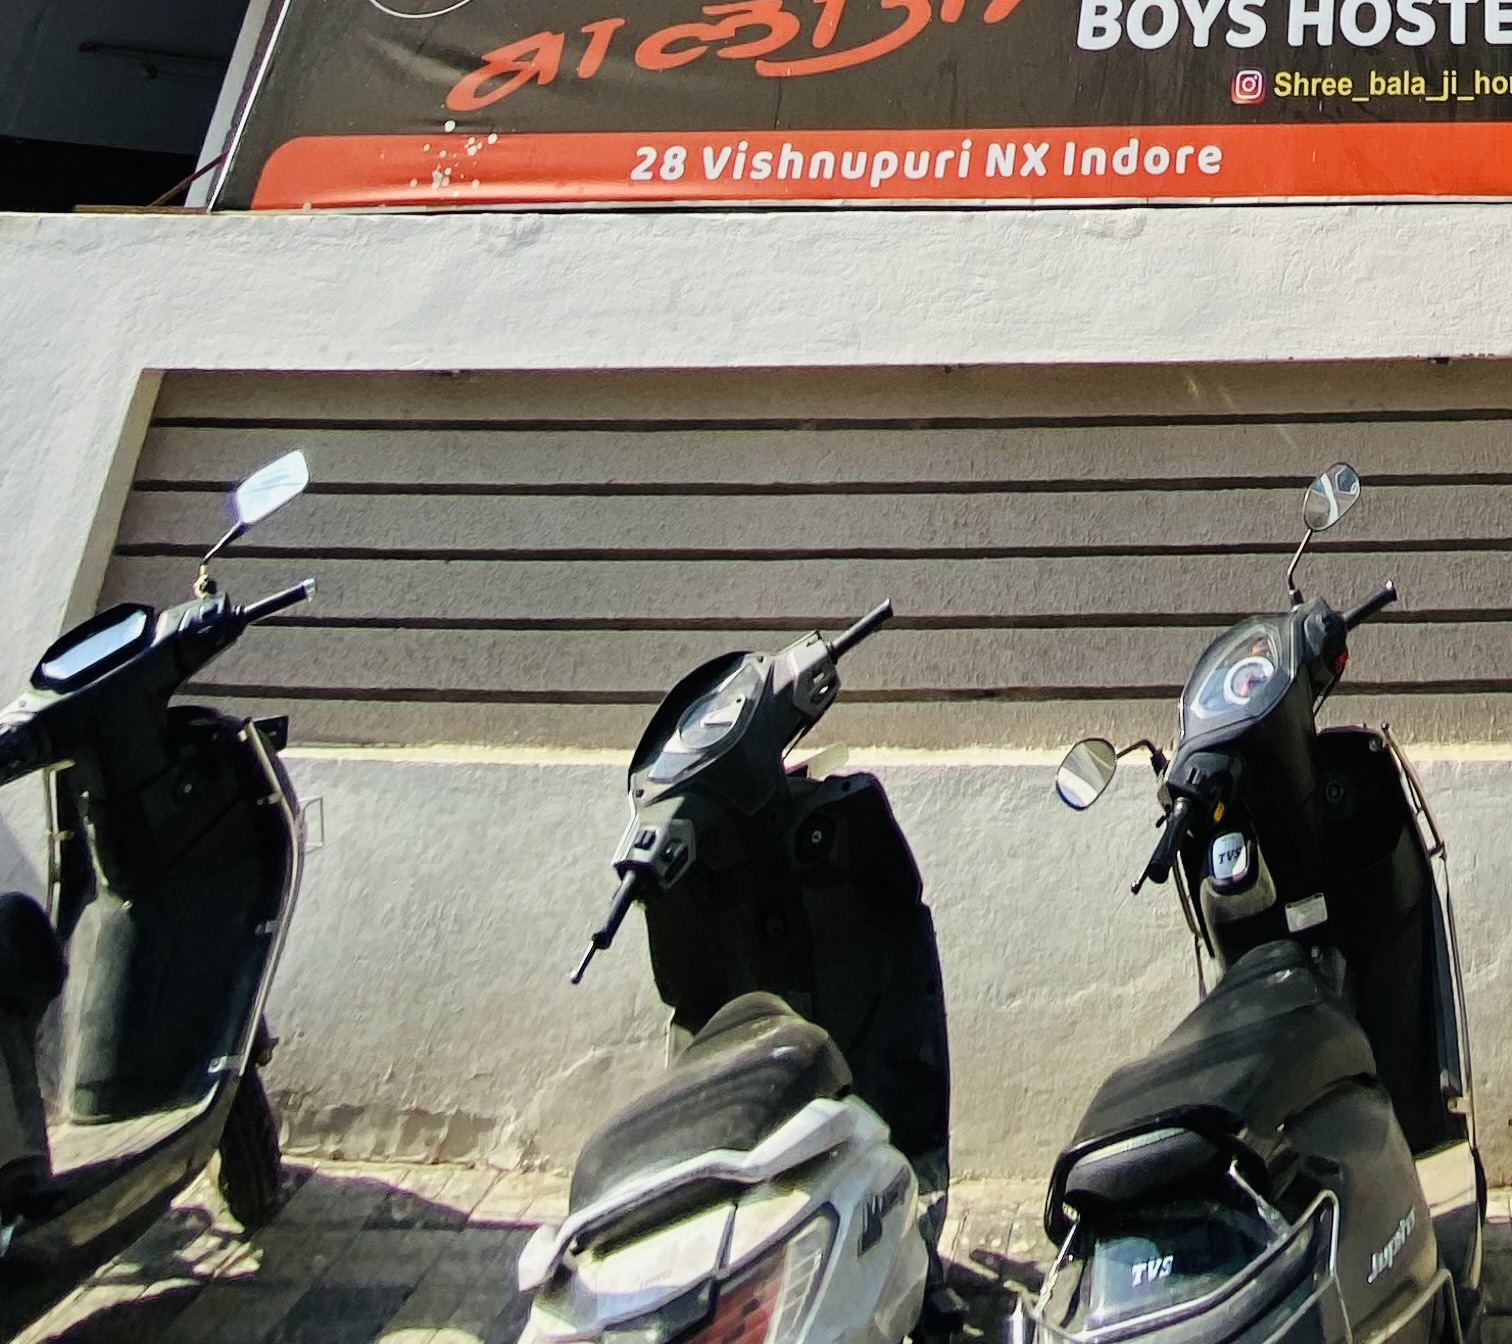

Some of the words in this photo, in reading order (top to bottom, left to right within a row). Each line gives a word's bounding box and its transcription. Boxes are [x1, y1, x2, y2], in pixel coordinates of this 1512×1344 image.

[630, 145, 688, 181] 28
[702, 139, 972, 188] Vishnupuri
[985, 142, 1051, 178] NX
[1062, 138, 1223, 176] Indore
[1131, 1255, 1175, 1288] TVS
